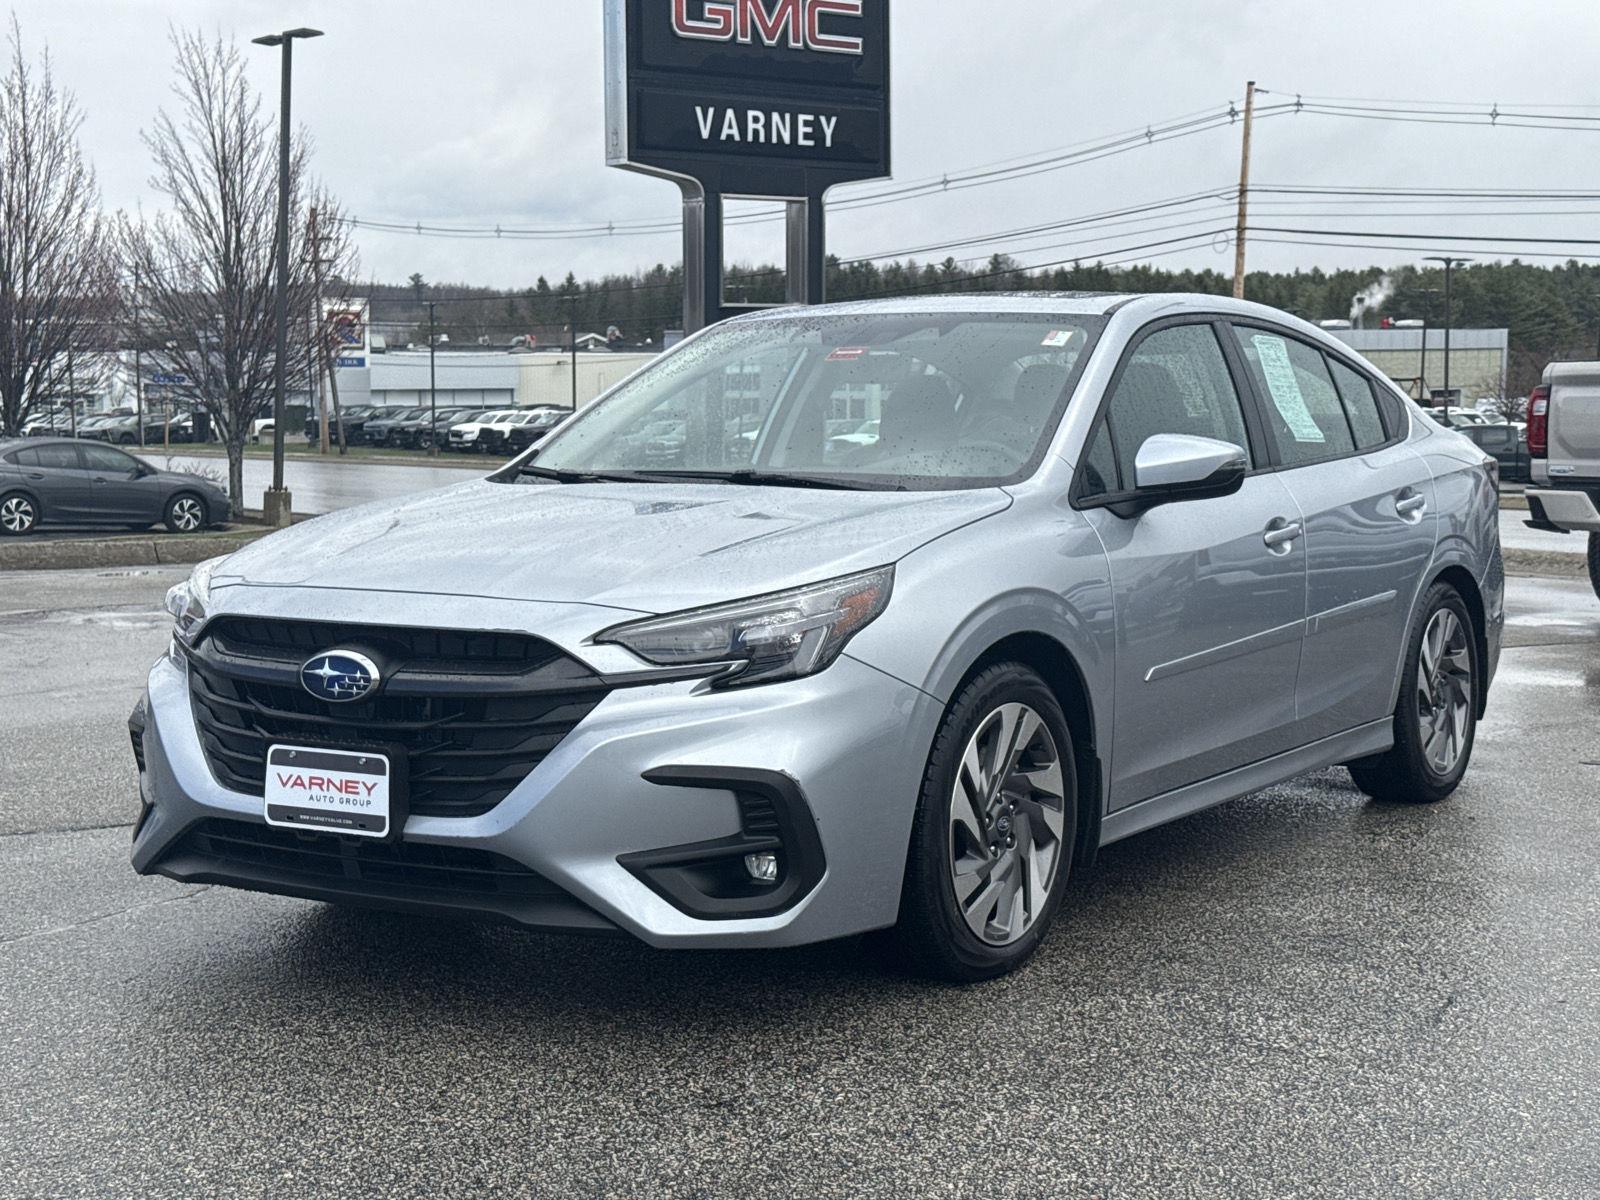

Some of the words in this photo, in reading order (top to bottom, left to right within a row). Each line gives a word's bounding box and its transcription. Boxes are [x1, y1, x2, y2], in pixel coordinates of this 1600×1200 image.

[671, 0, 863, 55] GMC
[695, 105, 838, 148] VARNEY
[277, 772, 378, 797] VARNEY
[309, 794, 335, 804] AUTO
[339, 797, 372, 808] GROUP
